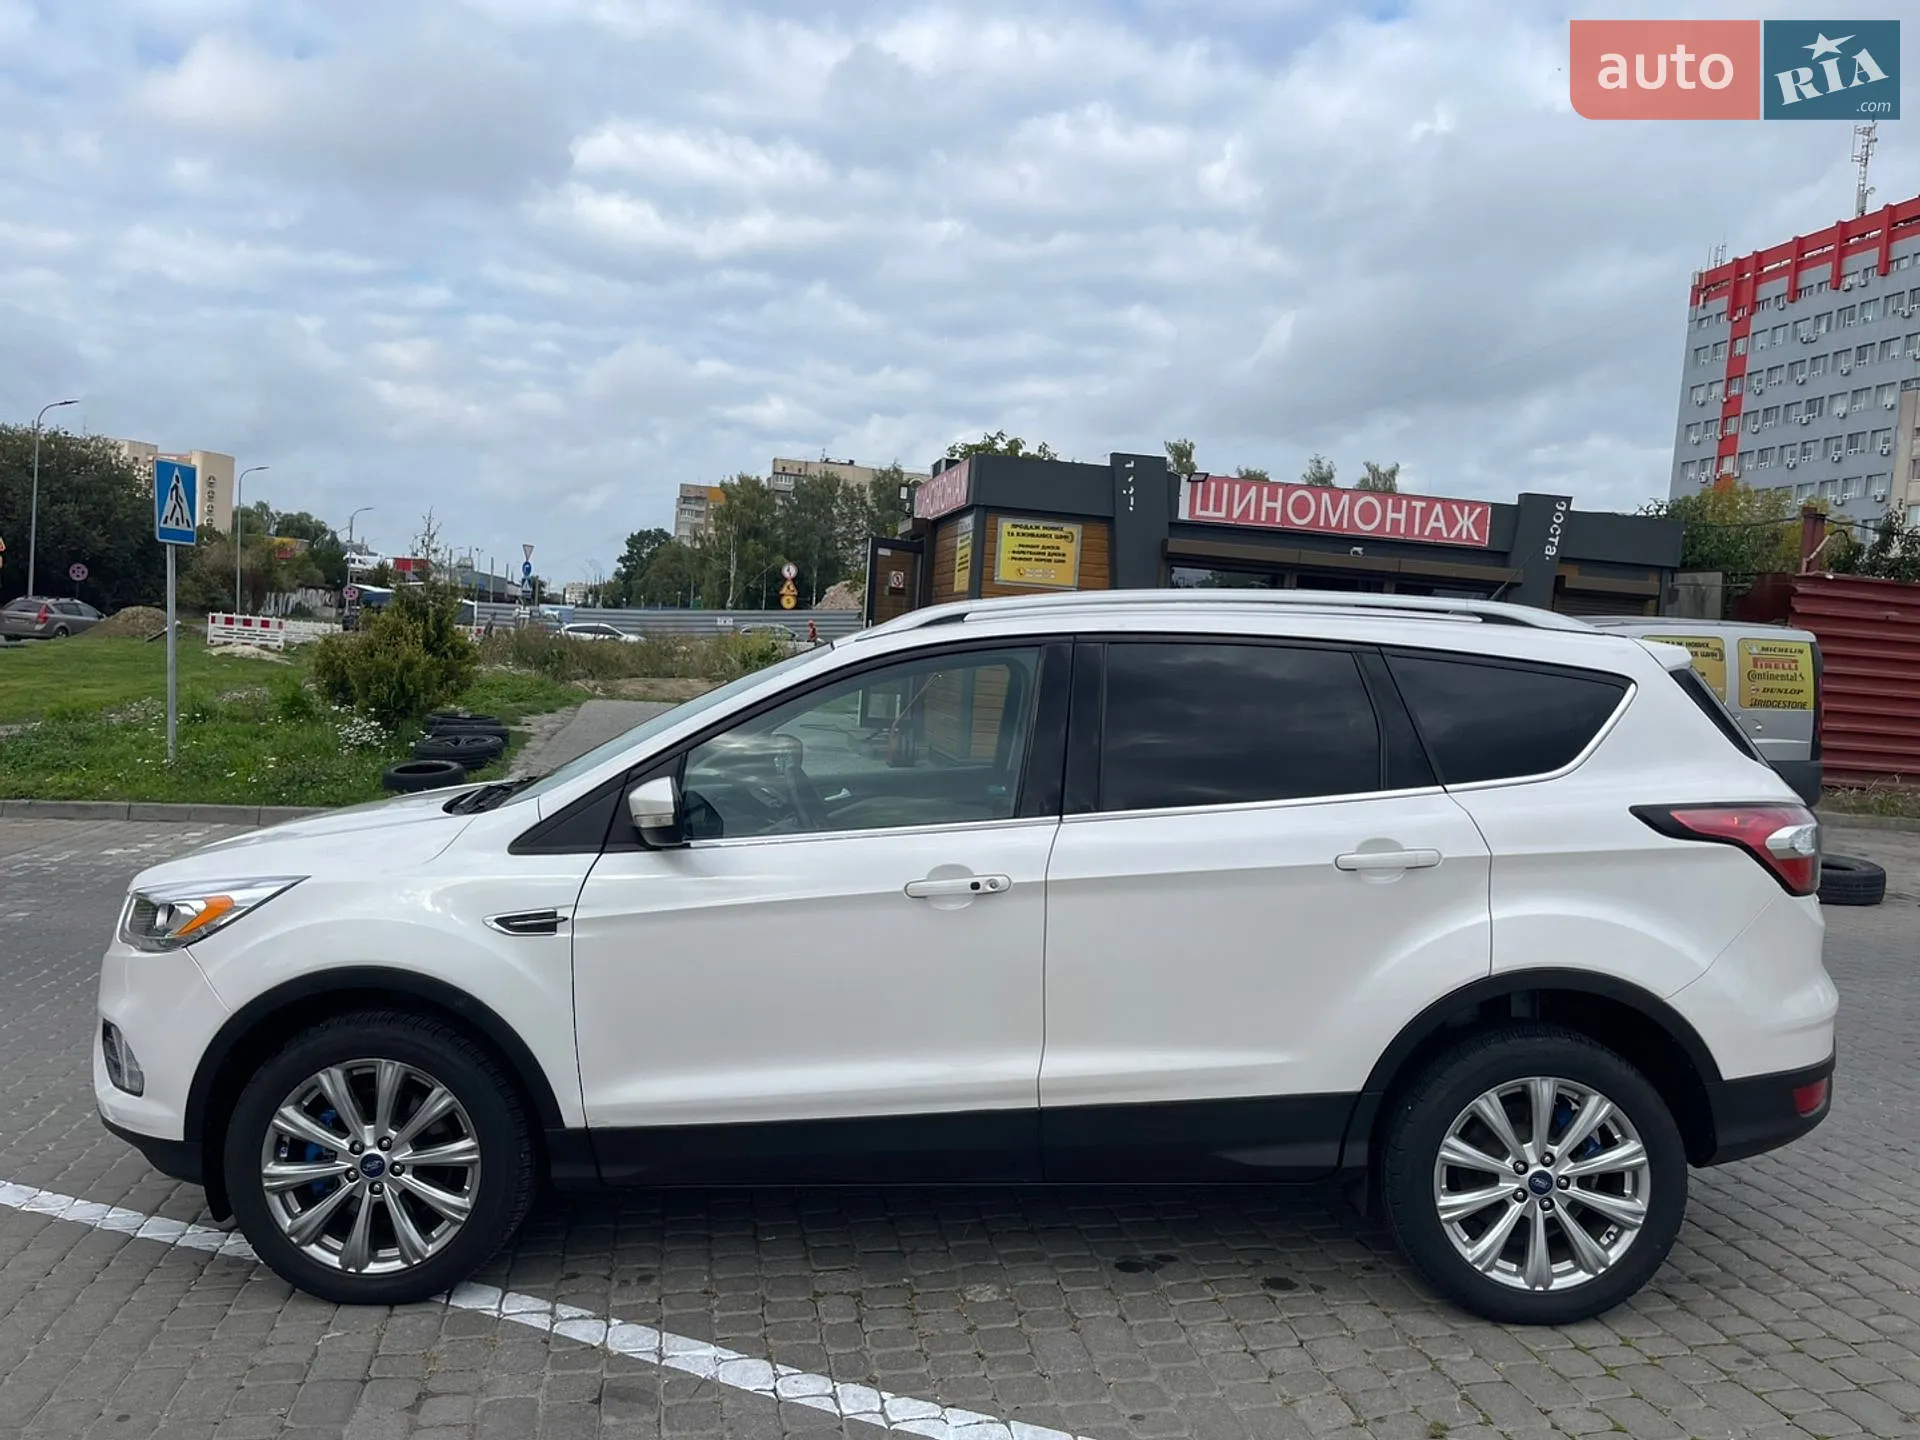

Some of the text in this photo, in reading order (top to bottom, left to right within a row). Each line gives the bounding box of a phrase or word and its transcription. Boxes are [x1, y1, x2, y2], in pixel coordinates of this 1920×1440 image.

[1195, 481, 1482, 541] ШИНОМОНТАЖ
[1761, 646, 1805, 654] MICHELIN
[1752, 657, 1799, 670] PIRELLI
[1747, 670, 1798, 682] Continental
[1761, 687, 1804, 695] DUNLOP
[1750, 698, 1808, 710] BRIDGESTONE
